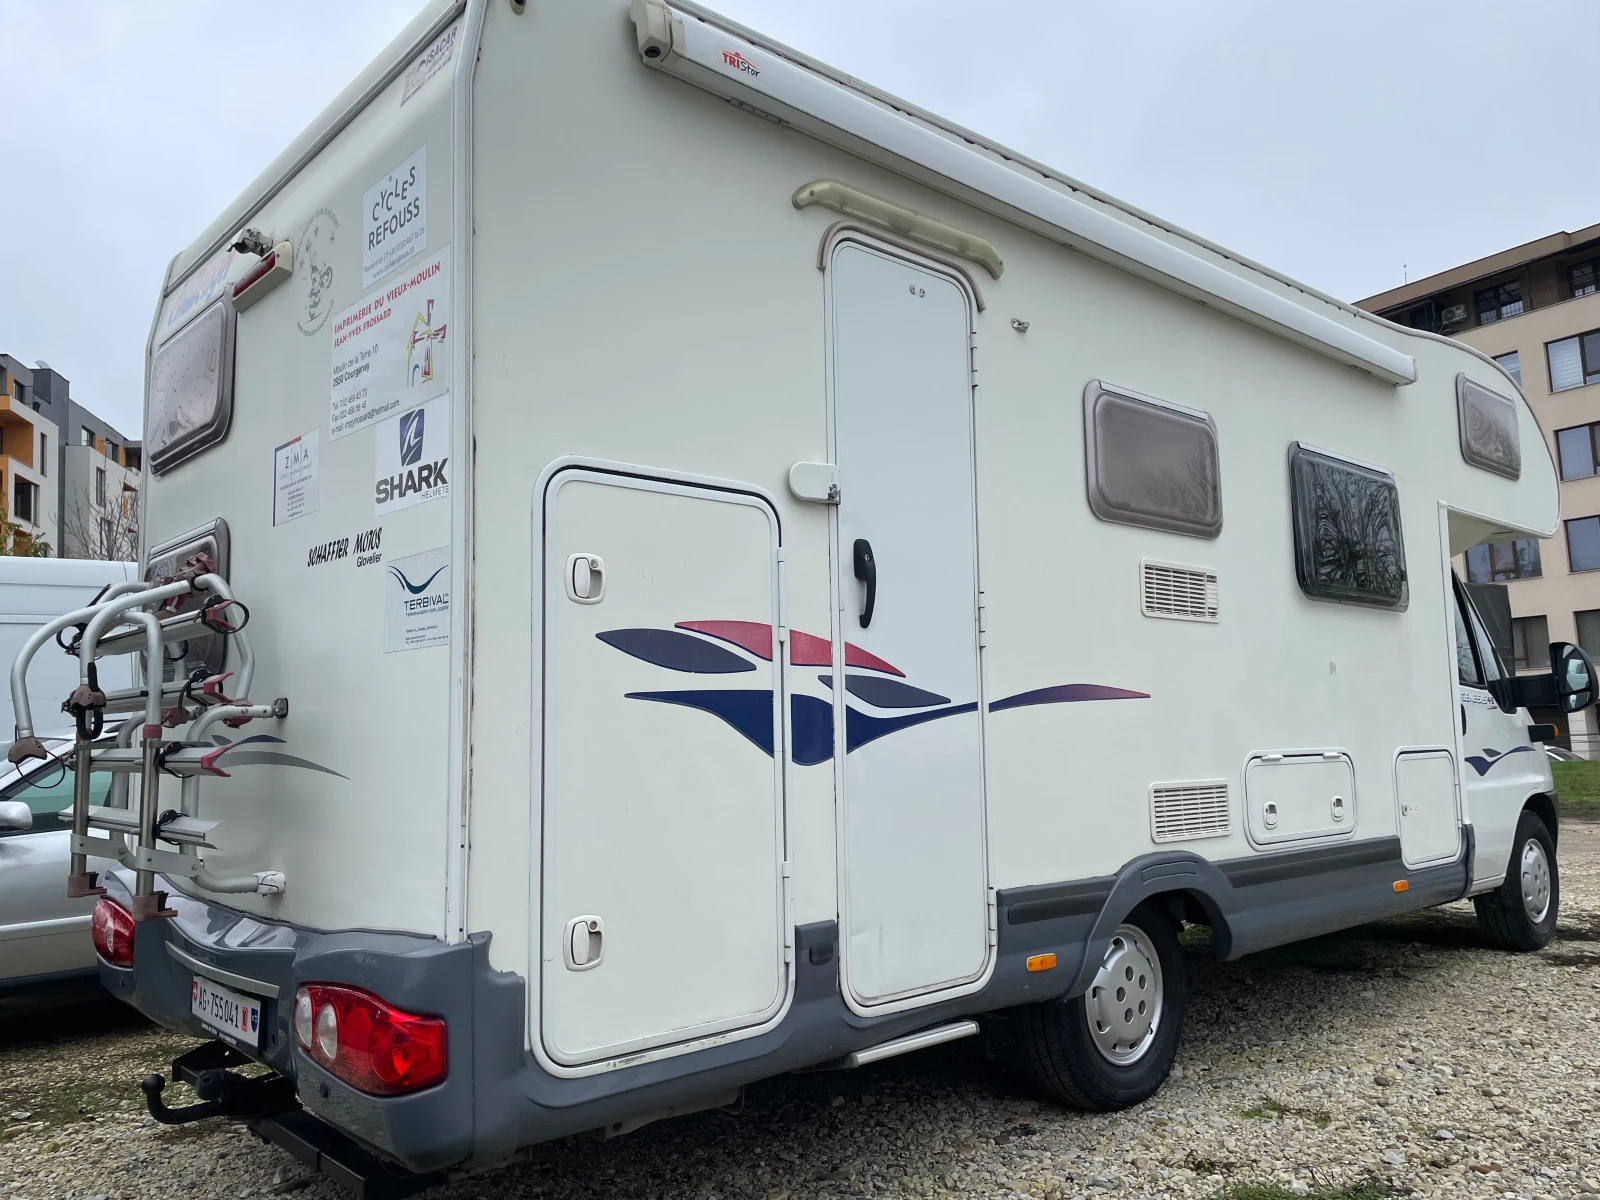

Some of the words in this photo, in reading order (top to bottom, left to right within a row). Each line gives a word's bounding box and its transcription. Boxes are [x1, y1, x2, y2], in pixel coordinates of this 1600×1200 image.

[372, 165, 415, 221] CYCLES
[368, 196, 420, 251] REFOUSS
[334, 304, 372, 335] IMPRIMERIE
[374, 296, 384, 310] DU
[387, 261, 440, 302] VIEUX-MOULIN
[334, 325, 361, 348] JEAN-YVES
[363, 308, 392, 331] FROSSARD
[333, 362, 347, 375] Moulin
[348, 358, 353, 368] de
[355, 356, 359, 364] la
[360, 349, 371, 361] Terre
[372, 344, 378, 355] 10
[344, 362, 370, 381] Courgenay
[362, 388, 367, 398] 73
[375, 458, 449, 504] SHARK
[421, 485, 449, 500] HELMETS
[353, 527, 382, 555] MOTOS
[356, 552, 382, 568] Glovelier
[404, 593, 449, 611] TERBIVAL
